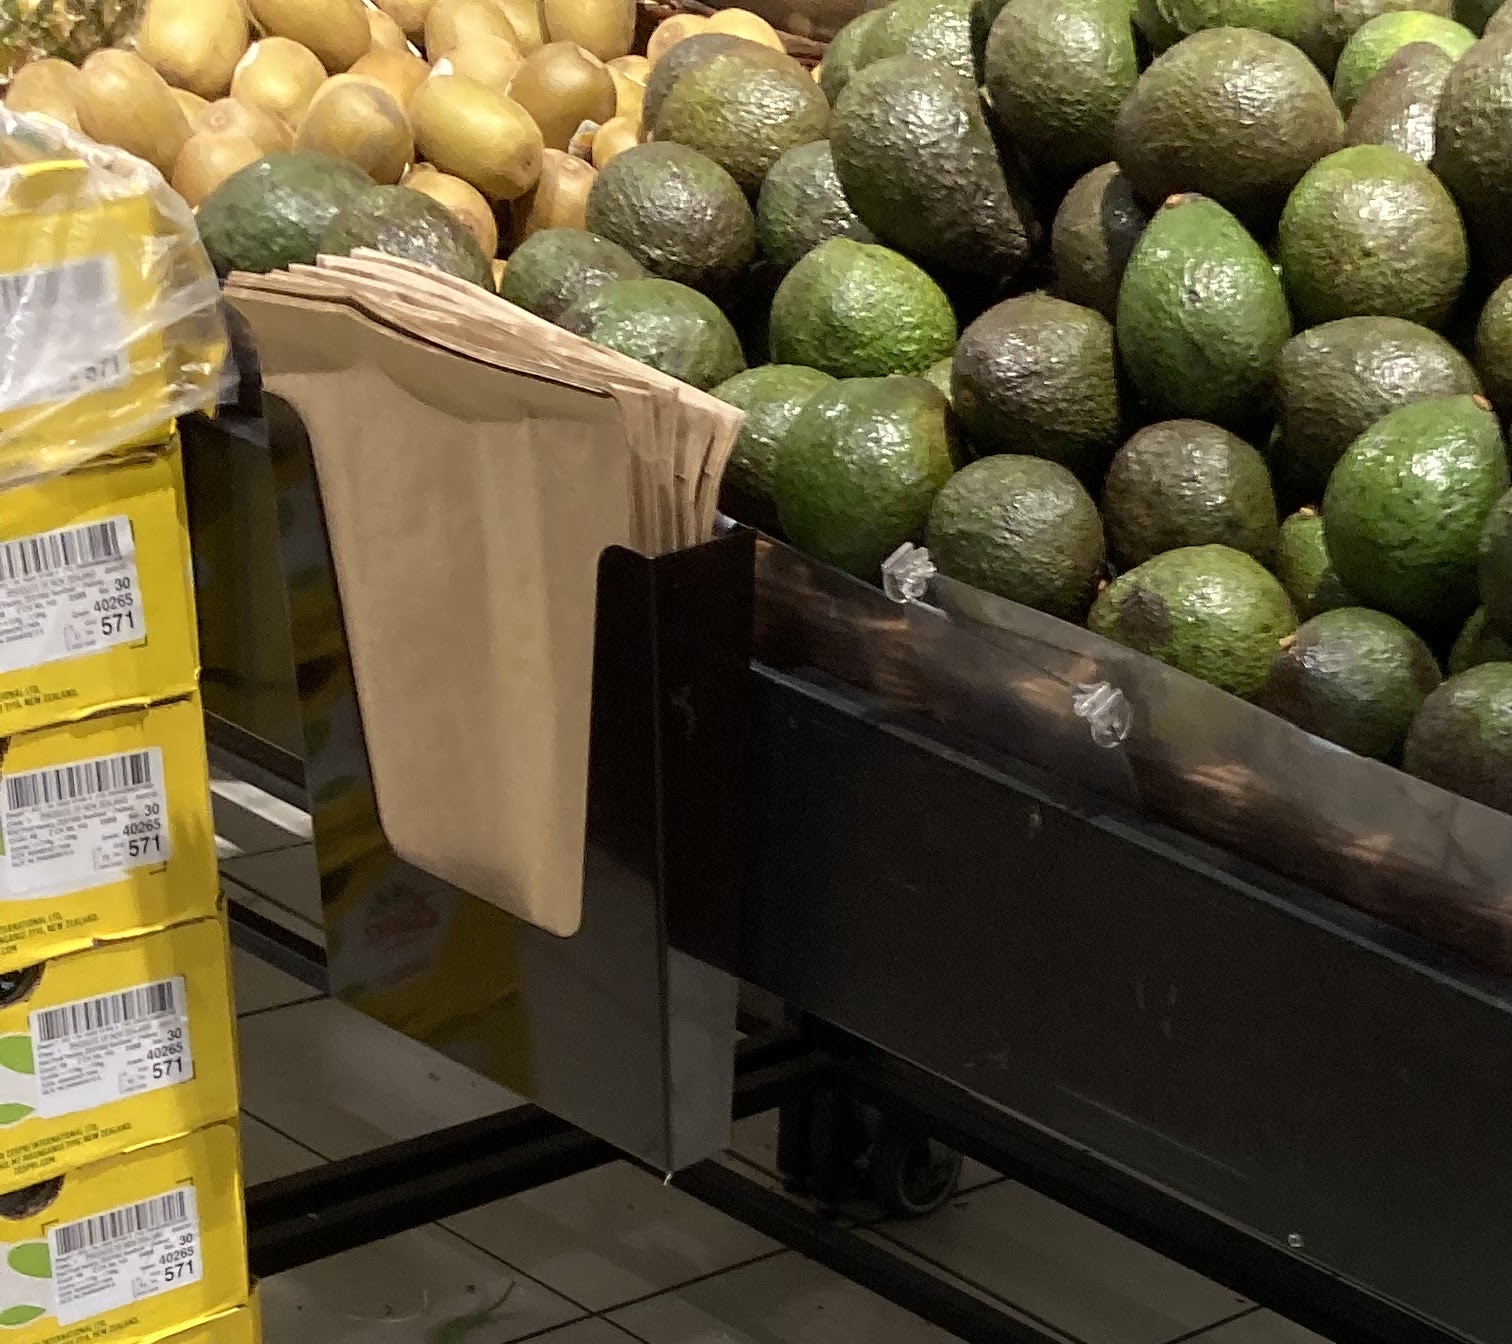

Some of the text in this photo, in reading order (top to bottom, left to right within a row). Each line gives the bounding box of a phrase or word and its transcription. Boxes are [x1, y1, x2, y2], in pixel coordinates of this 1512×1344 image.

[114, 577, 130, 591] 30
[93, 593, 134, 612] 40265
[101, 611, 134, 636] 571
[145, 803, 160, 817] 30
[122, 818, 161, 837] 40265
[128, 834, 161, 856] 571
[167, 1028, 182, 1041] 30
[147, 1044, 183, 1061] 40265
[152, 1057, 183, 1079] 571
[179, 1233, 193, 1246] 30
[159, 1248, 194, 1265] 40265
[164, 1259, 195, 1282] 571
